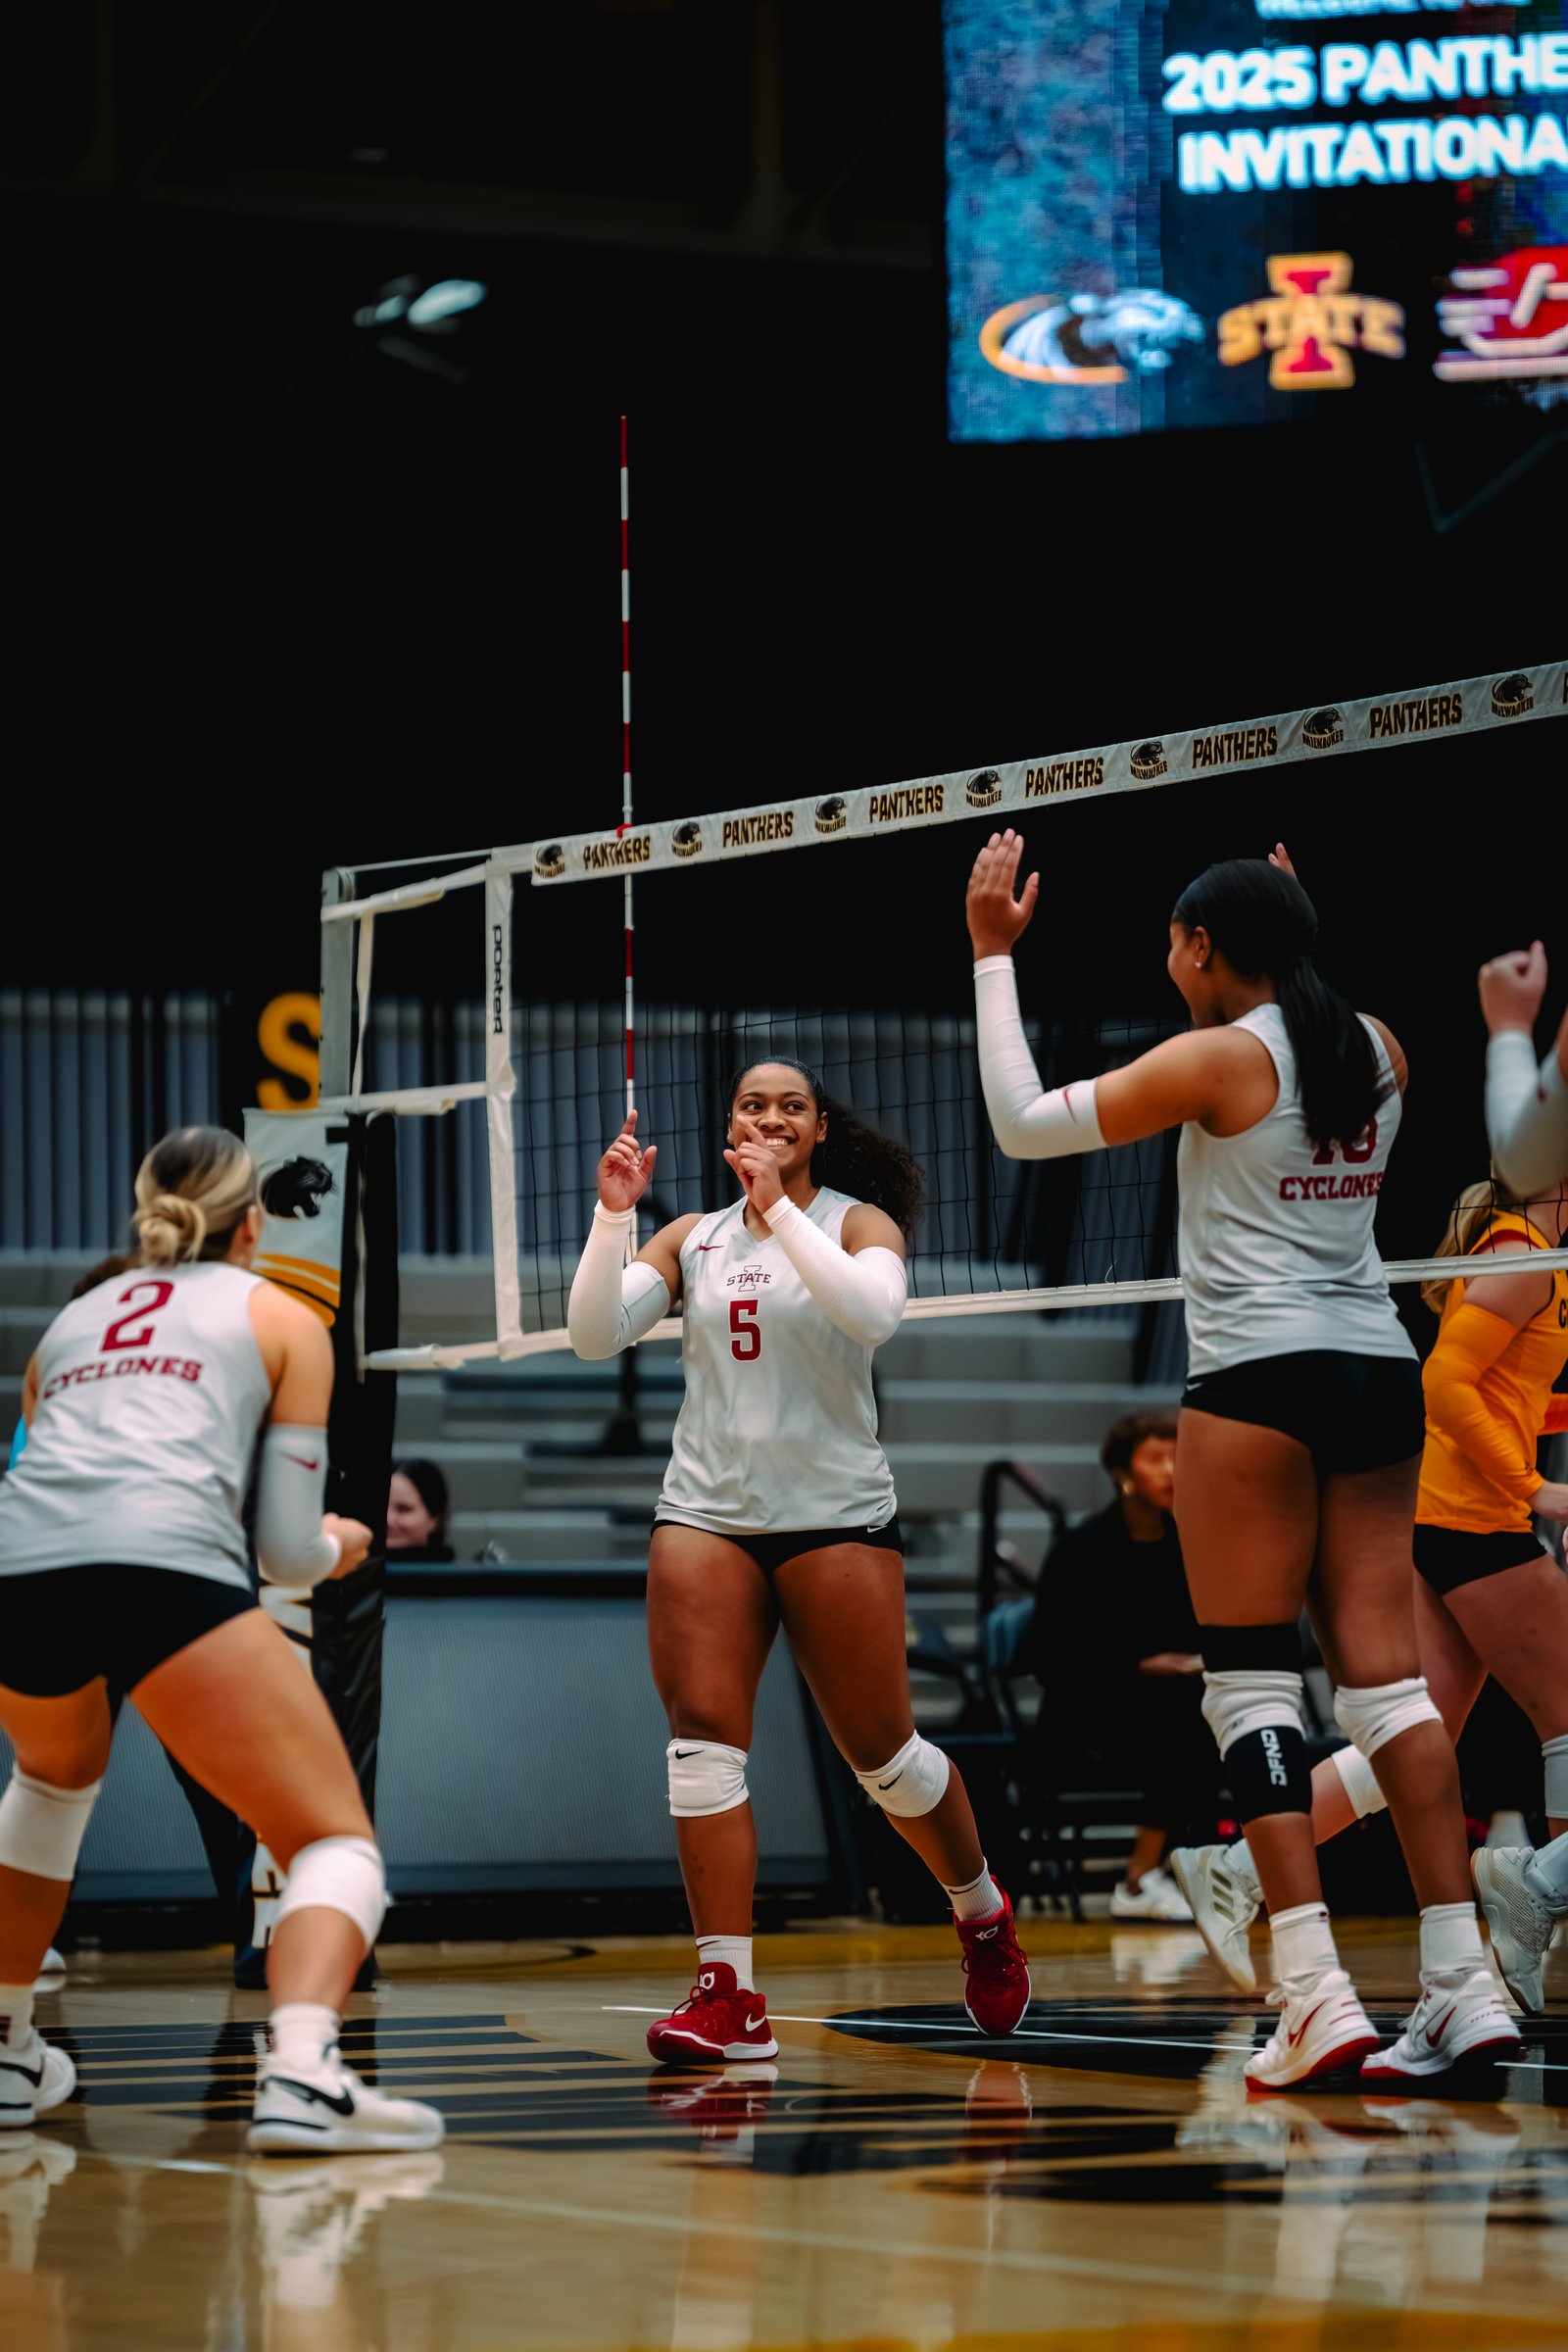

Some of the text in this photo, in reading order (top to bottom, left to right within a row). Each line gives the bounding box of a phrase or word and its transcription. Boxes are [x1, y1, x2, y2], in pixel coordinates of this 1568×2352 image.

[1163, 32, 1568, 115] 2025 PANTHE
[1179, 113, 1568, 193] INVITATIONA
[1217, 296, 1406, 367] STATE
[1369, 693, 1463, 739] PANTHERS
[1491, 696, 1535, 718] MILWAUKEE
[1192, 726, 1278, 769] PANTHERS
[1301, 728, 1345, 750] MILWAUKEE
[1025, 757, 1104, 800] PANTHERS
[1130, 760, 1168, 780] MILWAUKEE
[869, 784, 945, 823] PANTHERS
[965, 789, 1003, 808] MILWAUKEE
[722, 810, 795, 849] PANTHERS
[582, 836, 652, 870] PANTHERS
[726, 1273, 771, 1287] STATE
[101, 1280, 174, 1352] 2
[729, 1298, 761, 1361] 5
[43, 1355, 204, 1400] CYCLONES
